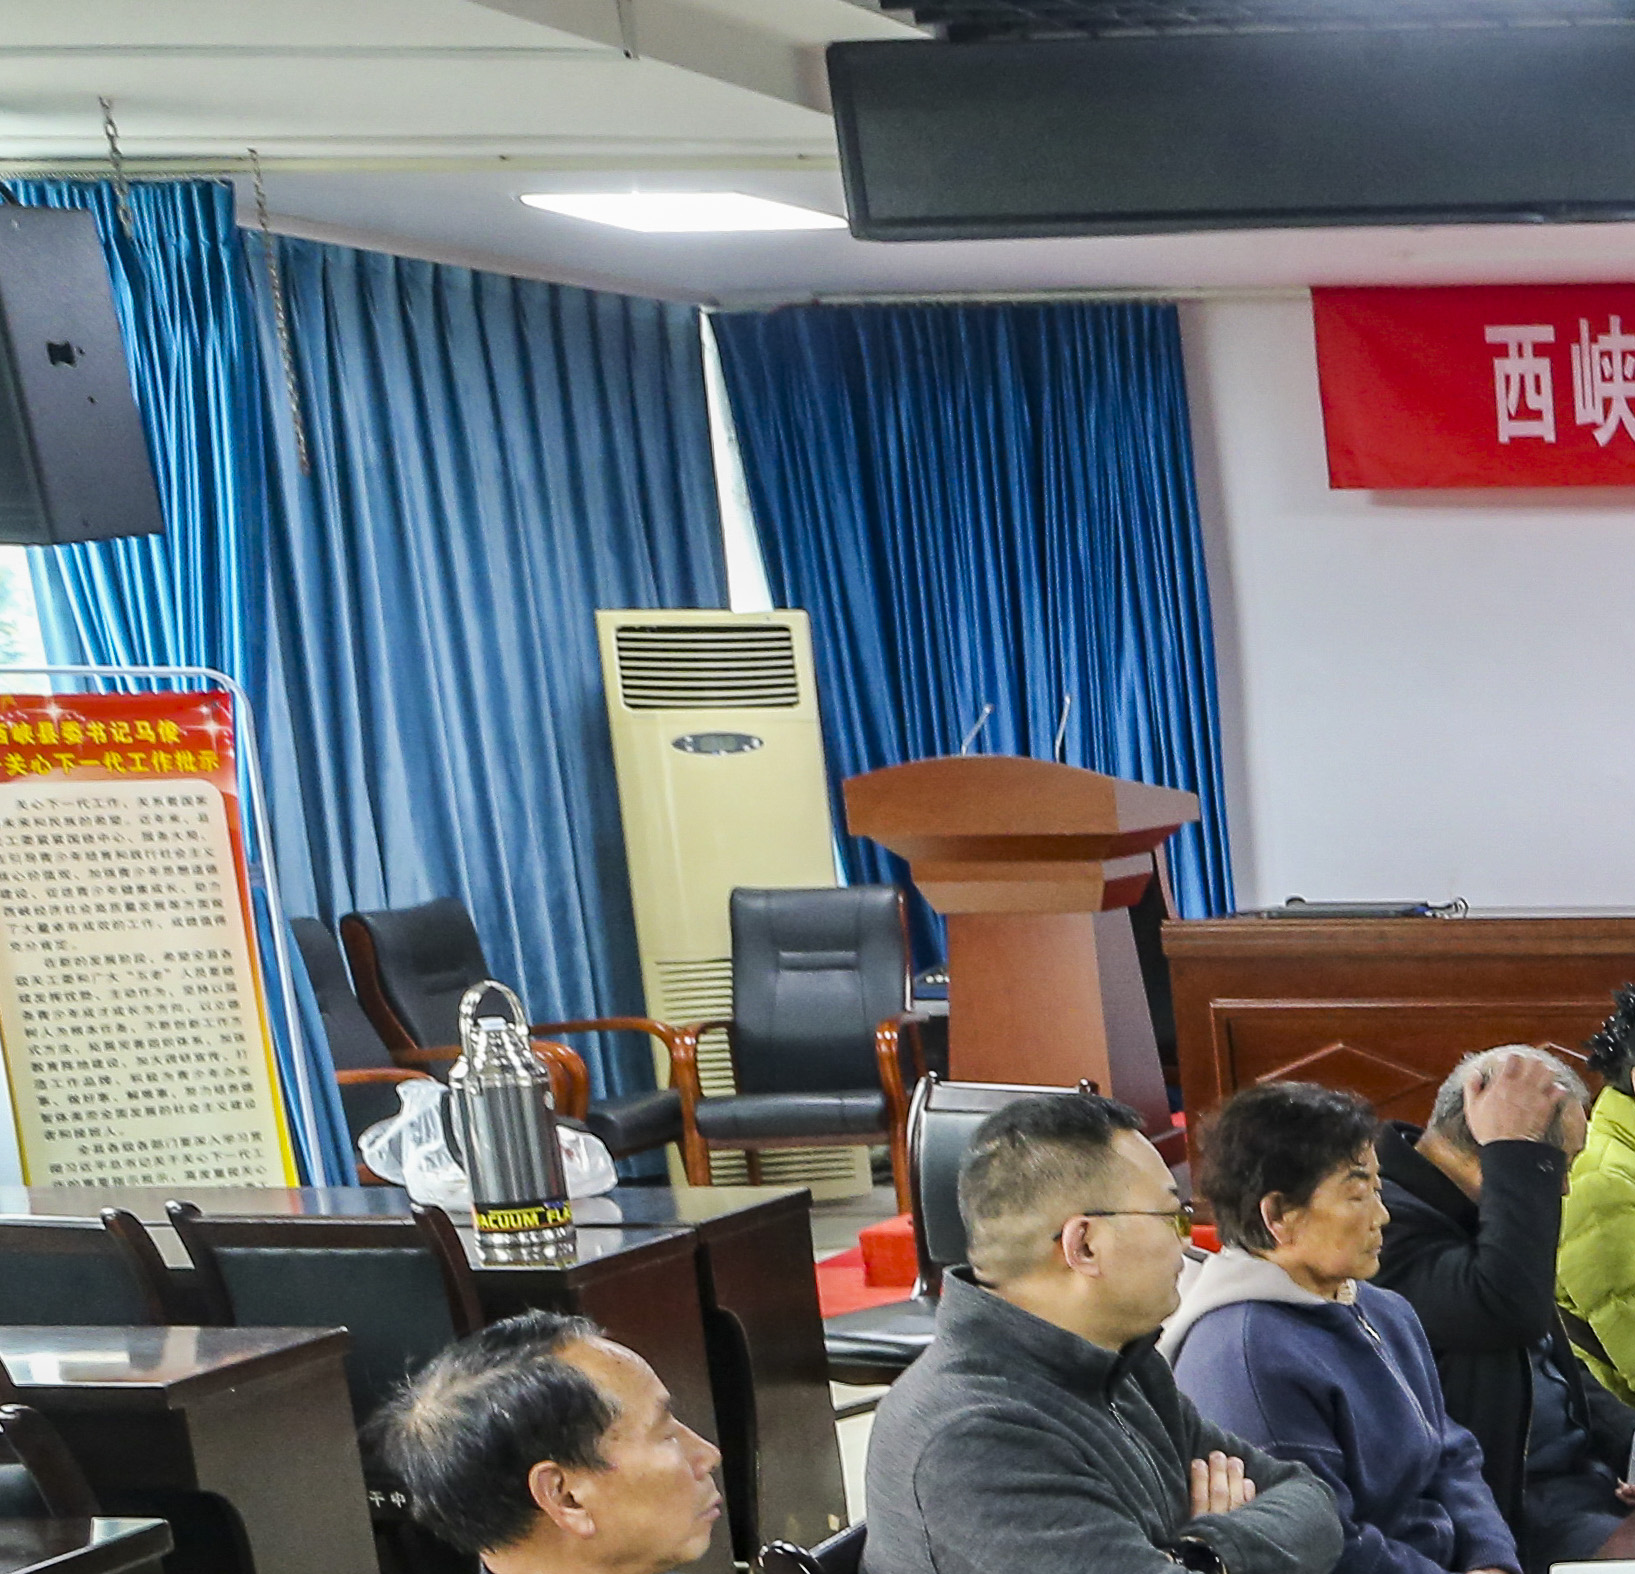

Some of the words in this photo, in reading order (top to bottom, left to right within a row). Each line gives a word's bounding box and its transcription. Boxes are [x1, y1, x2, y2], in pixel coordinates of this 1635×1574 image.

[0, 749, 220, 777] 关心下一代工作批示
[474, 1211, 540, 1229] ACUUM
